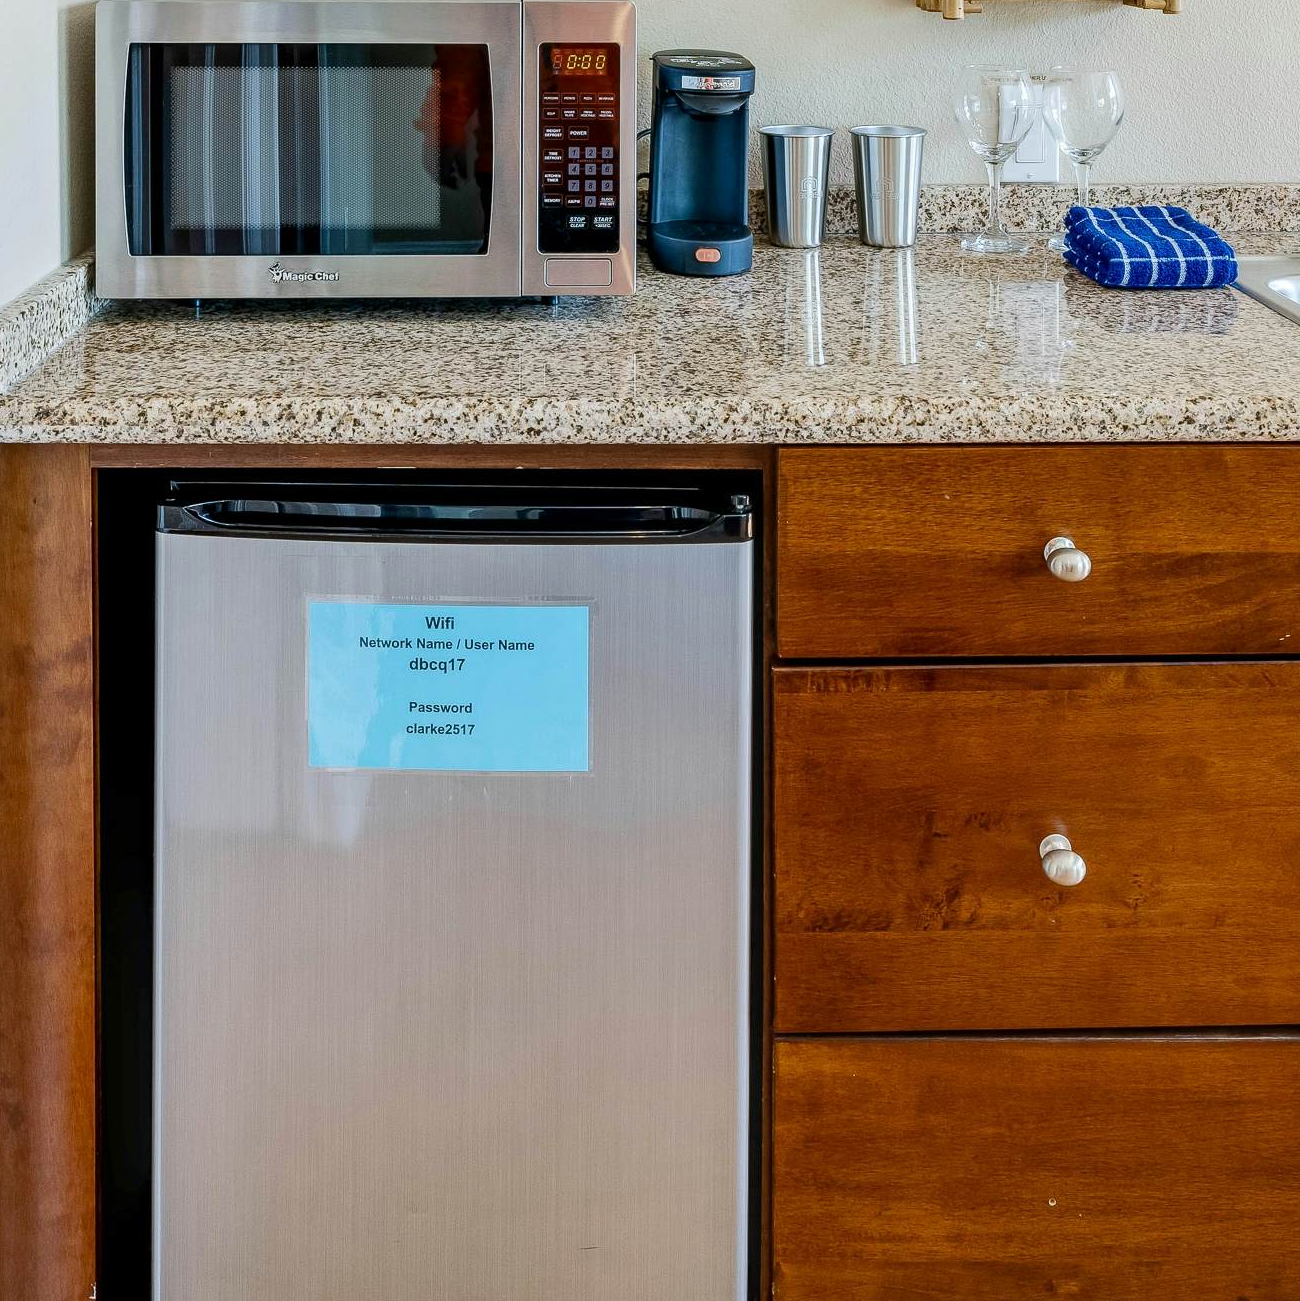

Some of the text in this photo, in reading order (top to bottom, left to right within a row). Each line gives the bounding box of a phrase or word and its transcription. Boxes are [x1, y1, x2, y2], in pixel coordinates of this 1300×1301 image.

[282, 271, 340, 283] Magic Chef
[425, 616, 455, 630] Wifi
[359, 636, 535, 651] Network Name / User Name
[409, 657, 466, 674] dbcq17
[408, 701, 473, 714] Password
[405, 723, 476, 735] clarke2517
